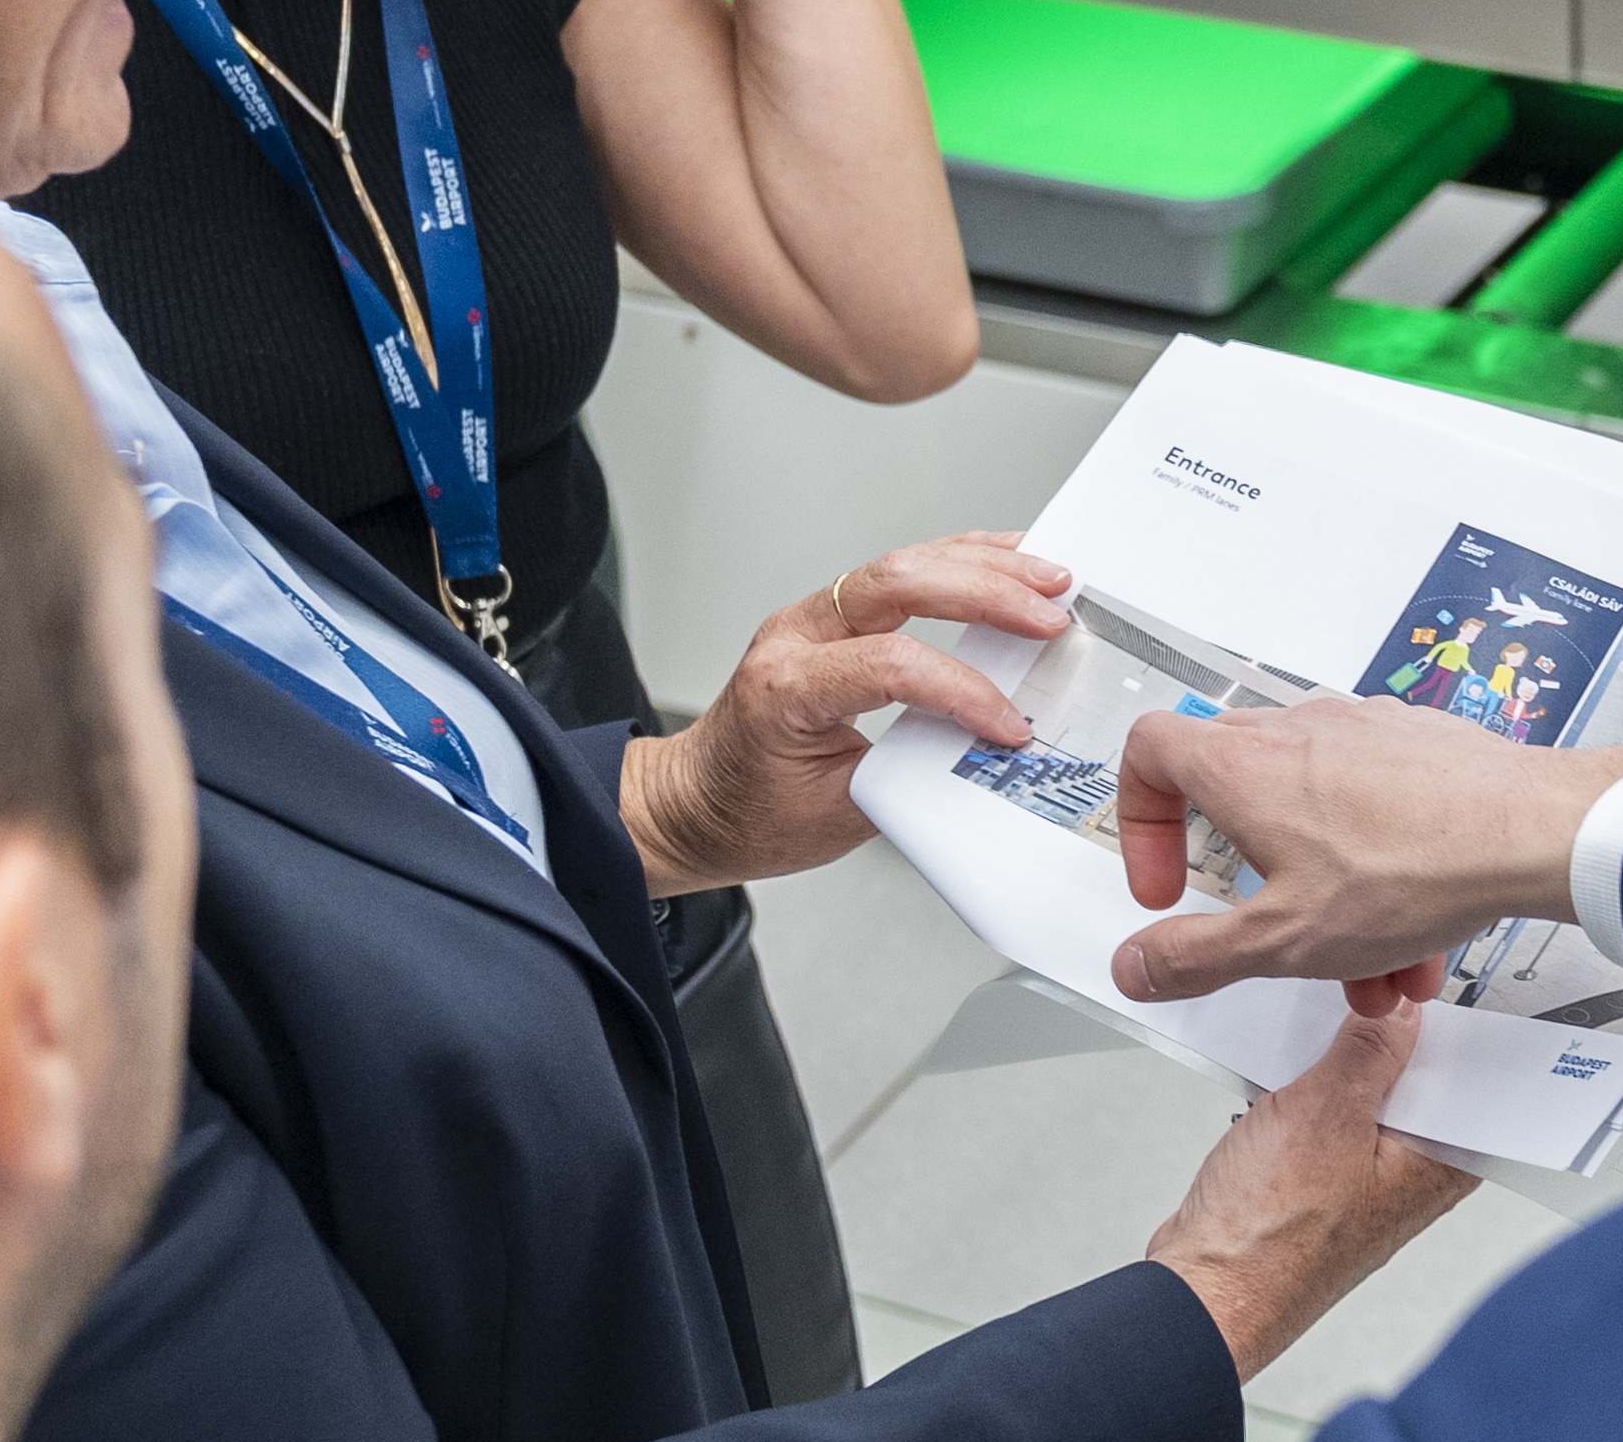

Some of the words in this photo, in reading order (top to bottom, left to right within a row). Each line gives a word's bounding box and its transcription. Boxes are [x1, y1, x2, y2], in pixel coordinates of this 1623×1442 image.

[215, 58, 269, 130] BUDAPEST
[233, 64, 277, 126] AIRPORT
[424, 147, 454, 231] BUDAPEST
[441, 158, 467, 226] AIRPORT
[375, 343, 406, 405] AIRPORT
[384, 335, 421, 409] BUDAPEST
[475, 416, 490, 484] AIRPORT
[1164, 446, 1261, 500] Entrance
[1152, 467, 1184, 489] Family
[1191, 485, 1215, 501] PRM
[1215, 494, 1240, 513] lanes
[1549, 576, 1600, 604] CSALÁDI
[1550, 1064, 1596, 1081] AIRPORT
[1558, 1053, 1612, 1071] BUDAPEST
